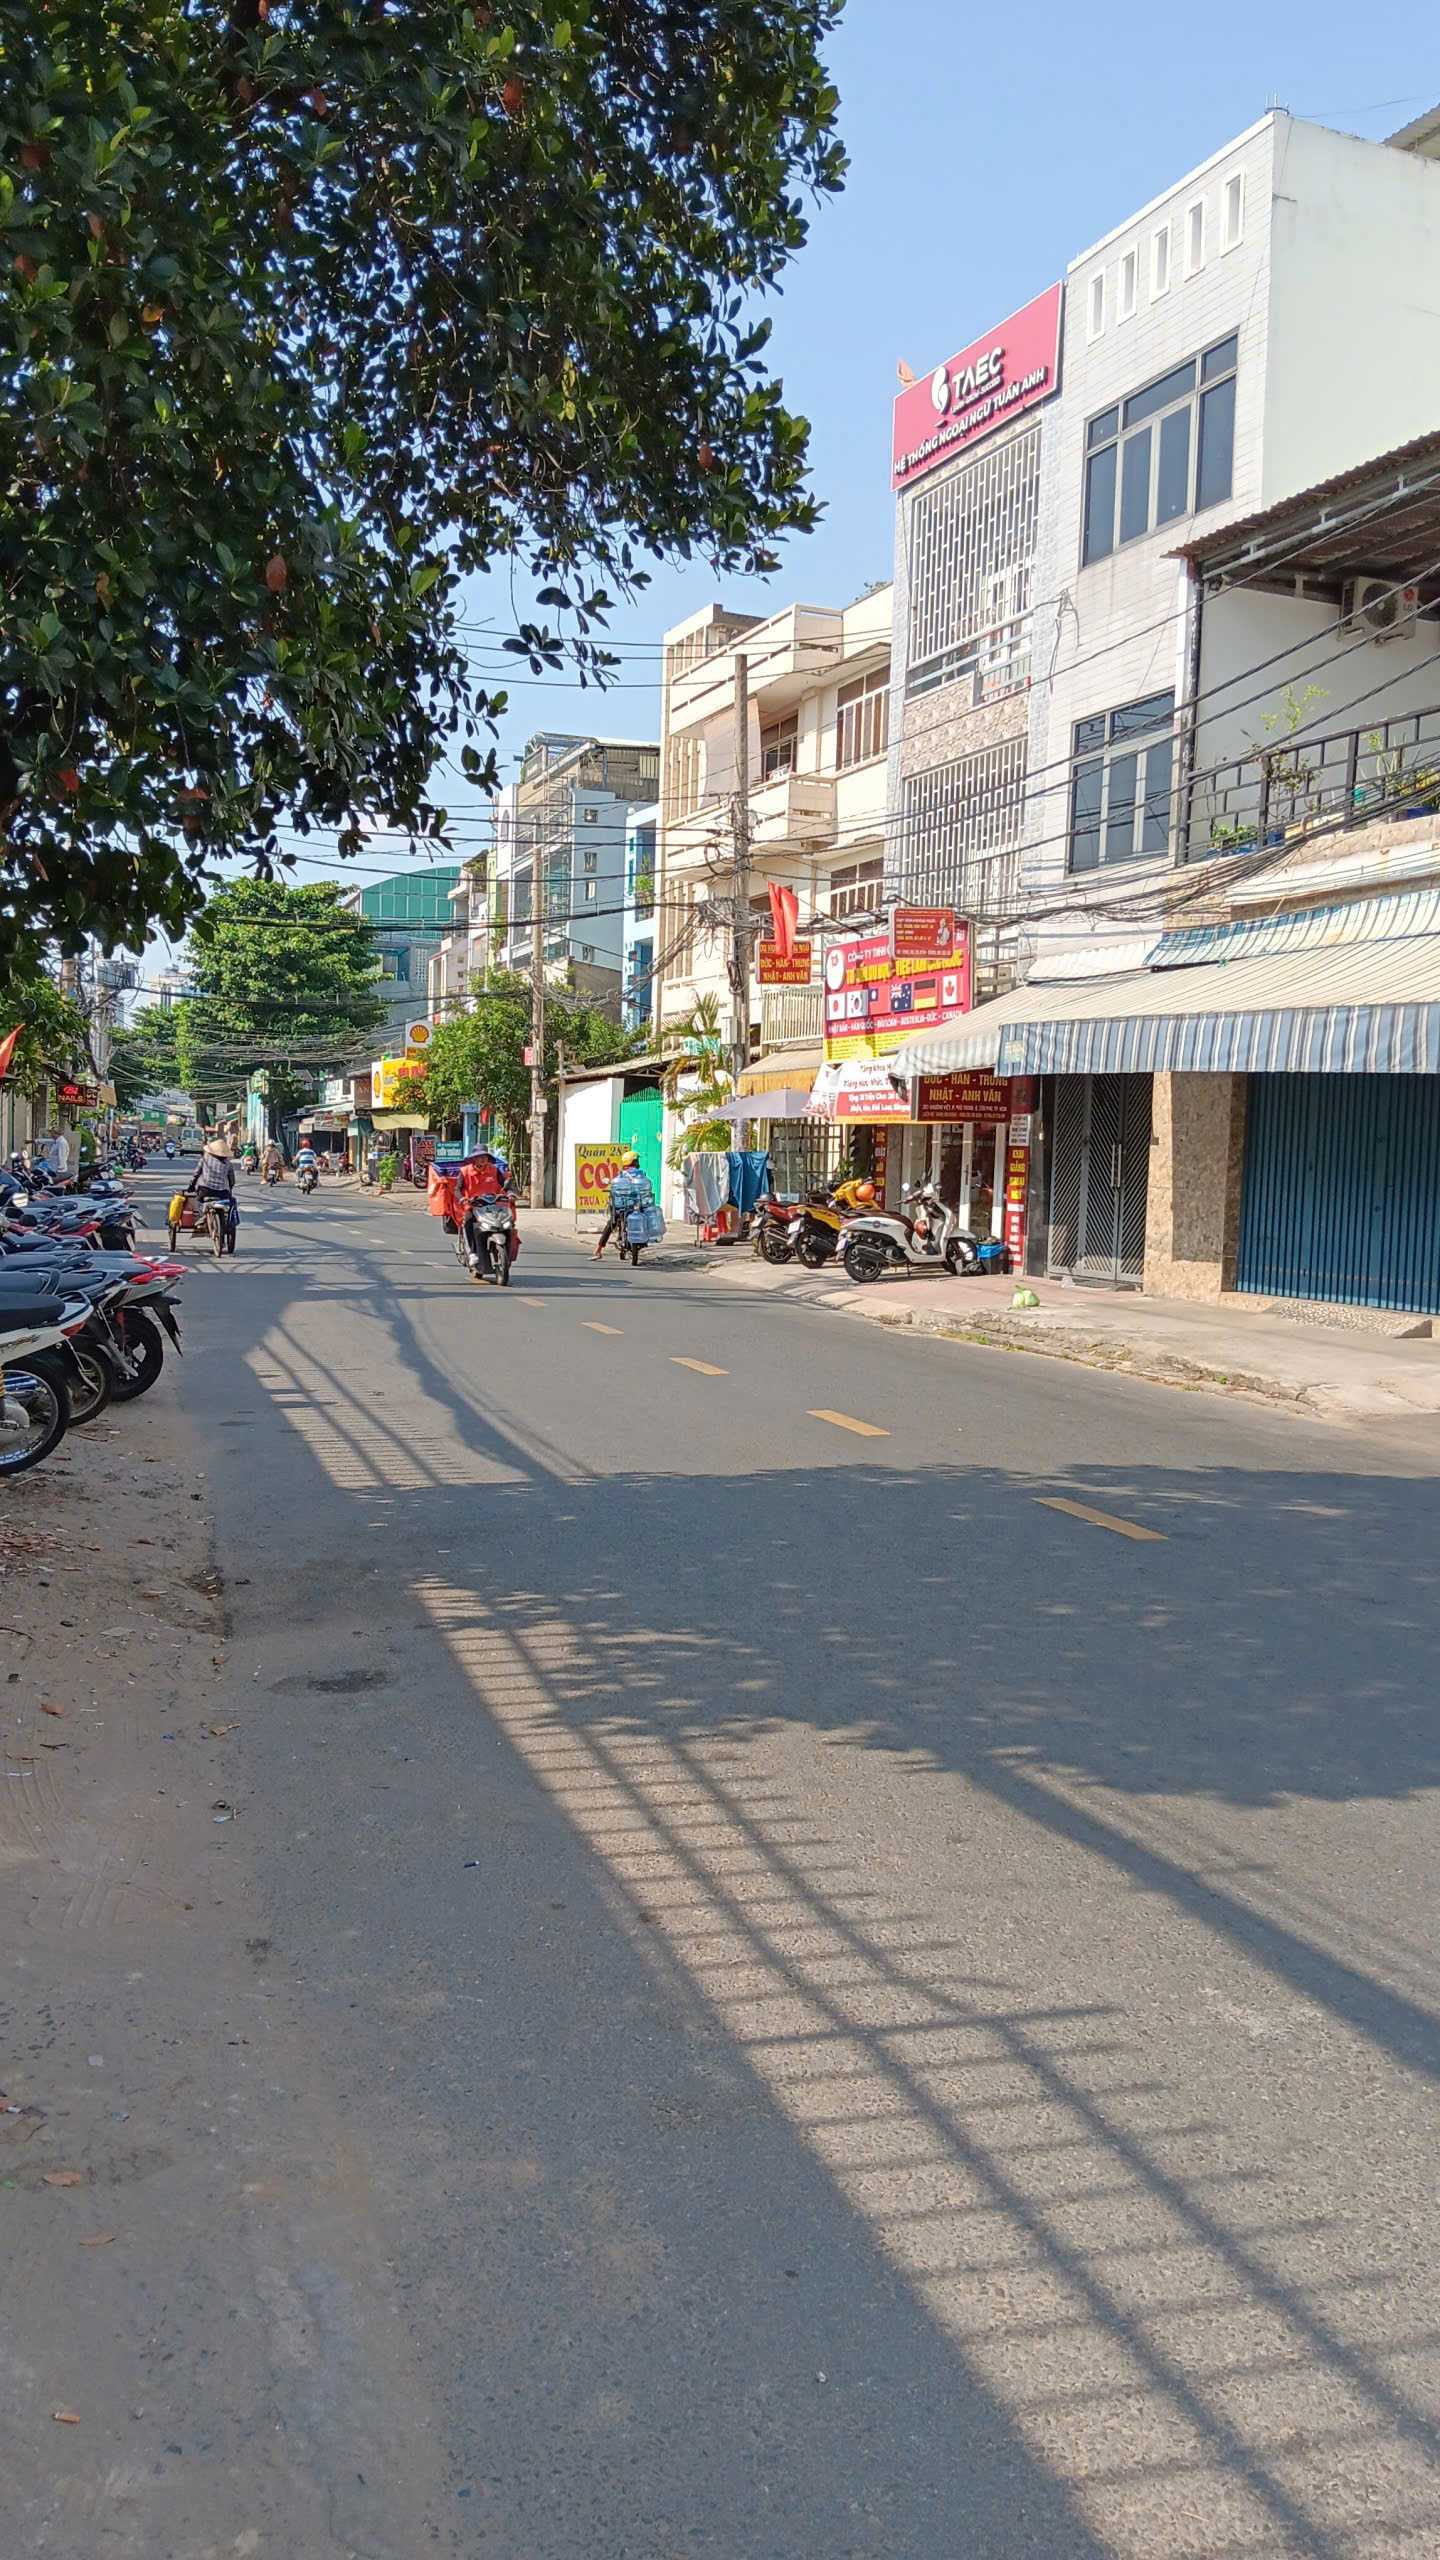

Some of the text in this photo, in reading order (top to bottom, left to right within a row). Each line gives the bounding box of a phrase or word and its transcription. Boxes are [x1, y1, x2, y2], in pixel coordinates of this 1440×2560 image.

[952, 346, 1003, 400] TAEC
[895, 454, 907, 475] HỆ
[907, 437, 938, 467] THỐNG
[938, 417, 969, 448] NGOẠI
[992, 381, 1021, 411] TUẤN
[1019, 366, 1046, 394] ANH
[929, 1087, 954, 1104] NHẬT
[961, 1089, 981, 1102] ANH
[983, 1088, 1002, 1102] VĂN
[578, 1145, 606, 1158] Quán
